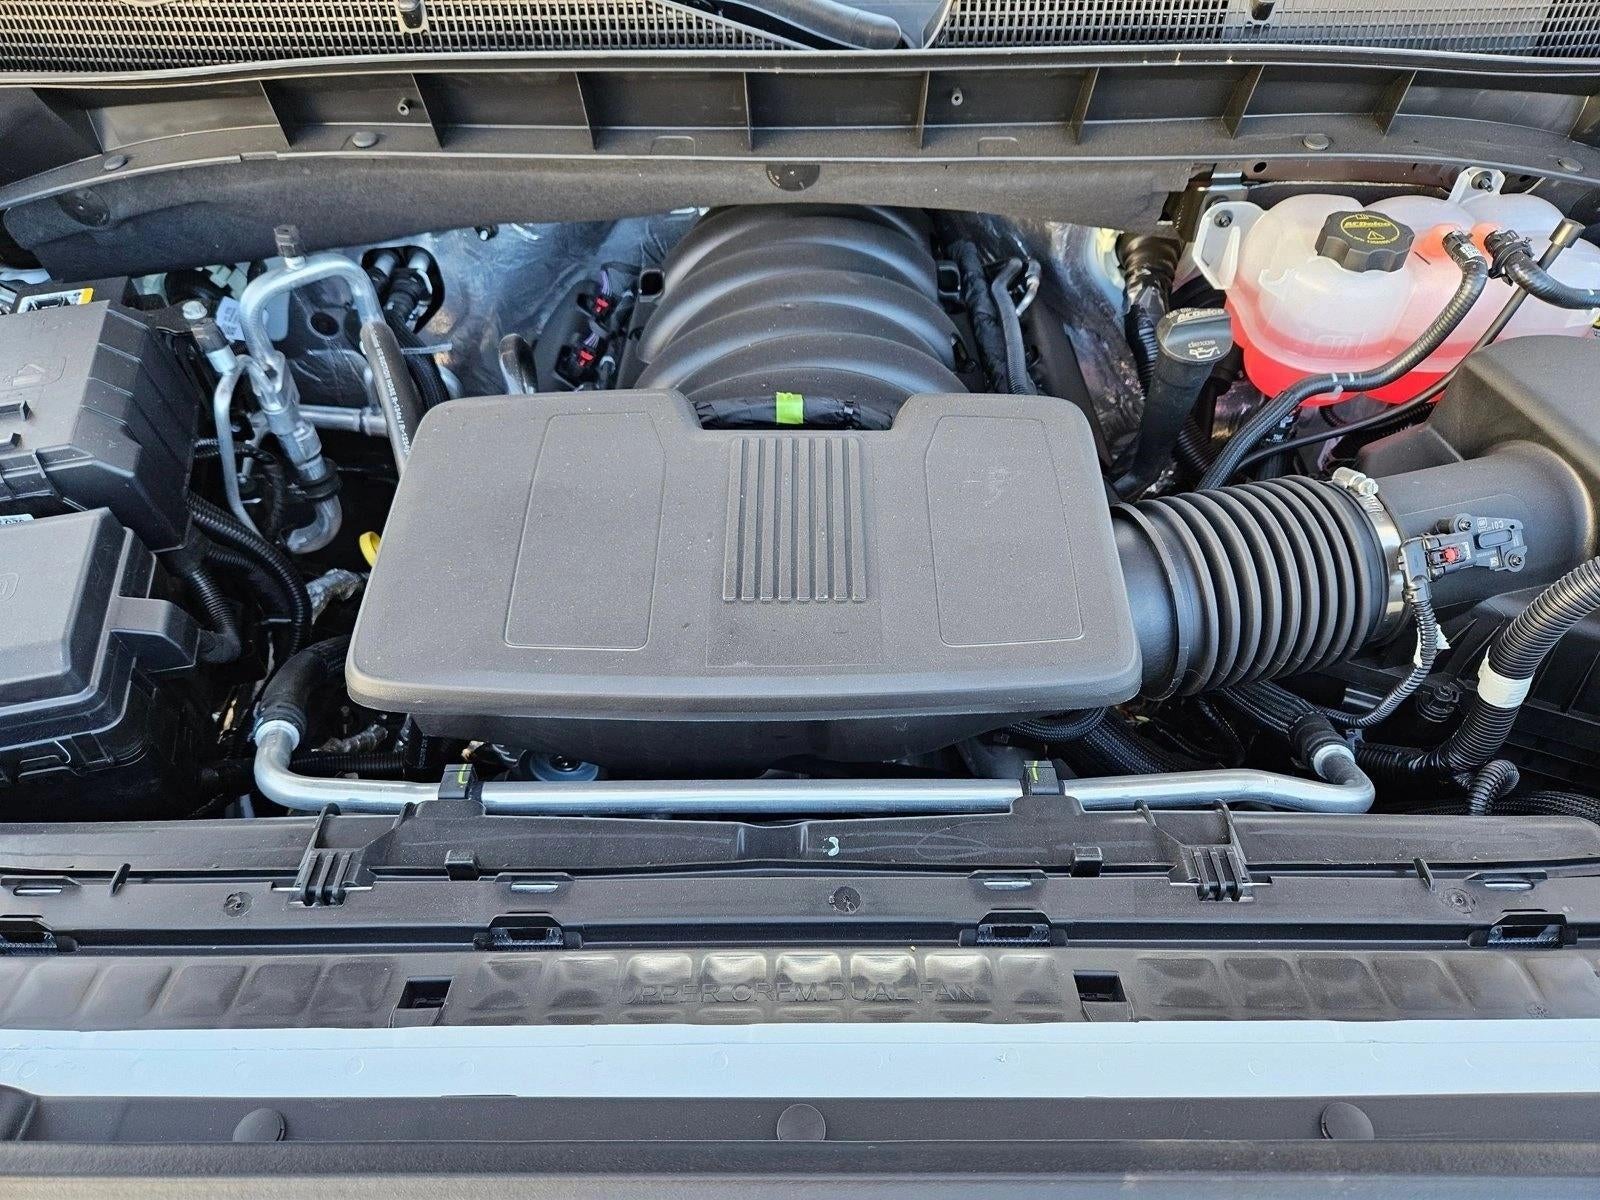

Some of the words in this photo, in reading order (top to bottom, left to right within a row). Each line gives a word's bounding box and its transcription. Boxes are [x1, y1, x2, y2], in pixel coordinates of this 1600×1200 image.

[618, 983, 720, 1004] UPPER
[829, 982, 910, 1002] DUAL
[918, 982, 978, 1002] FAN
